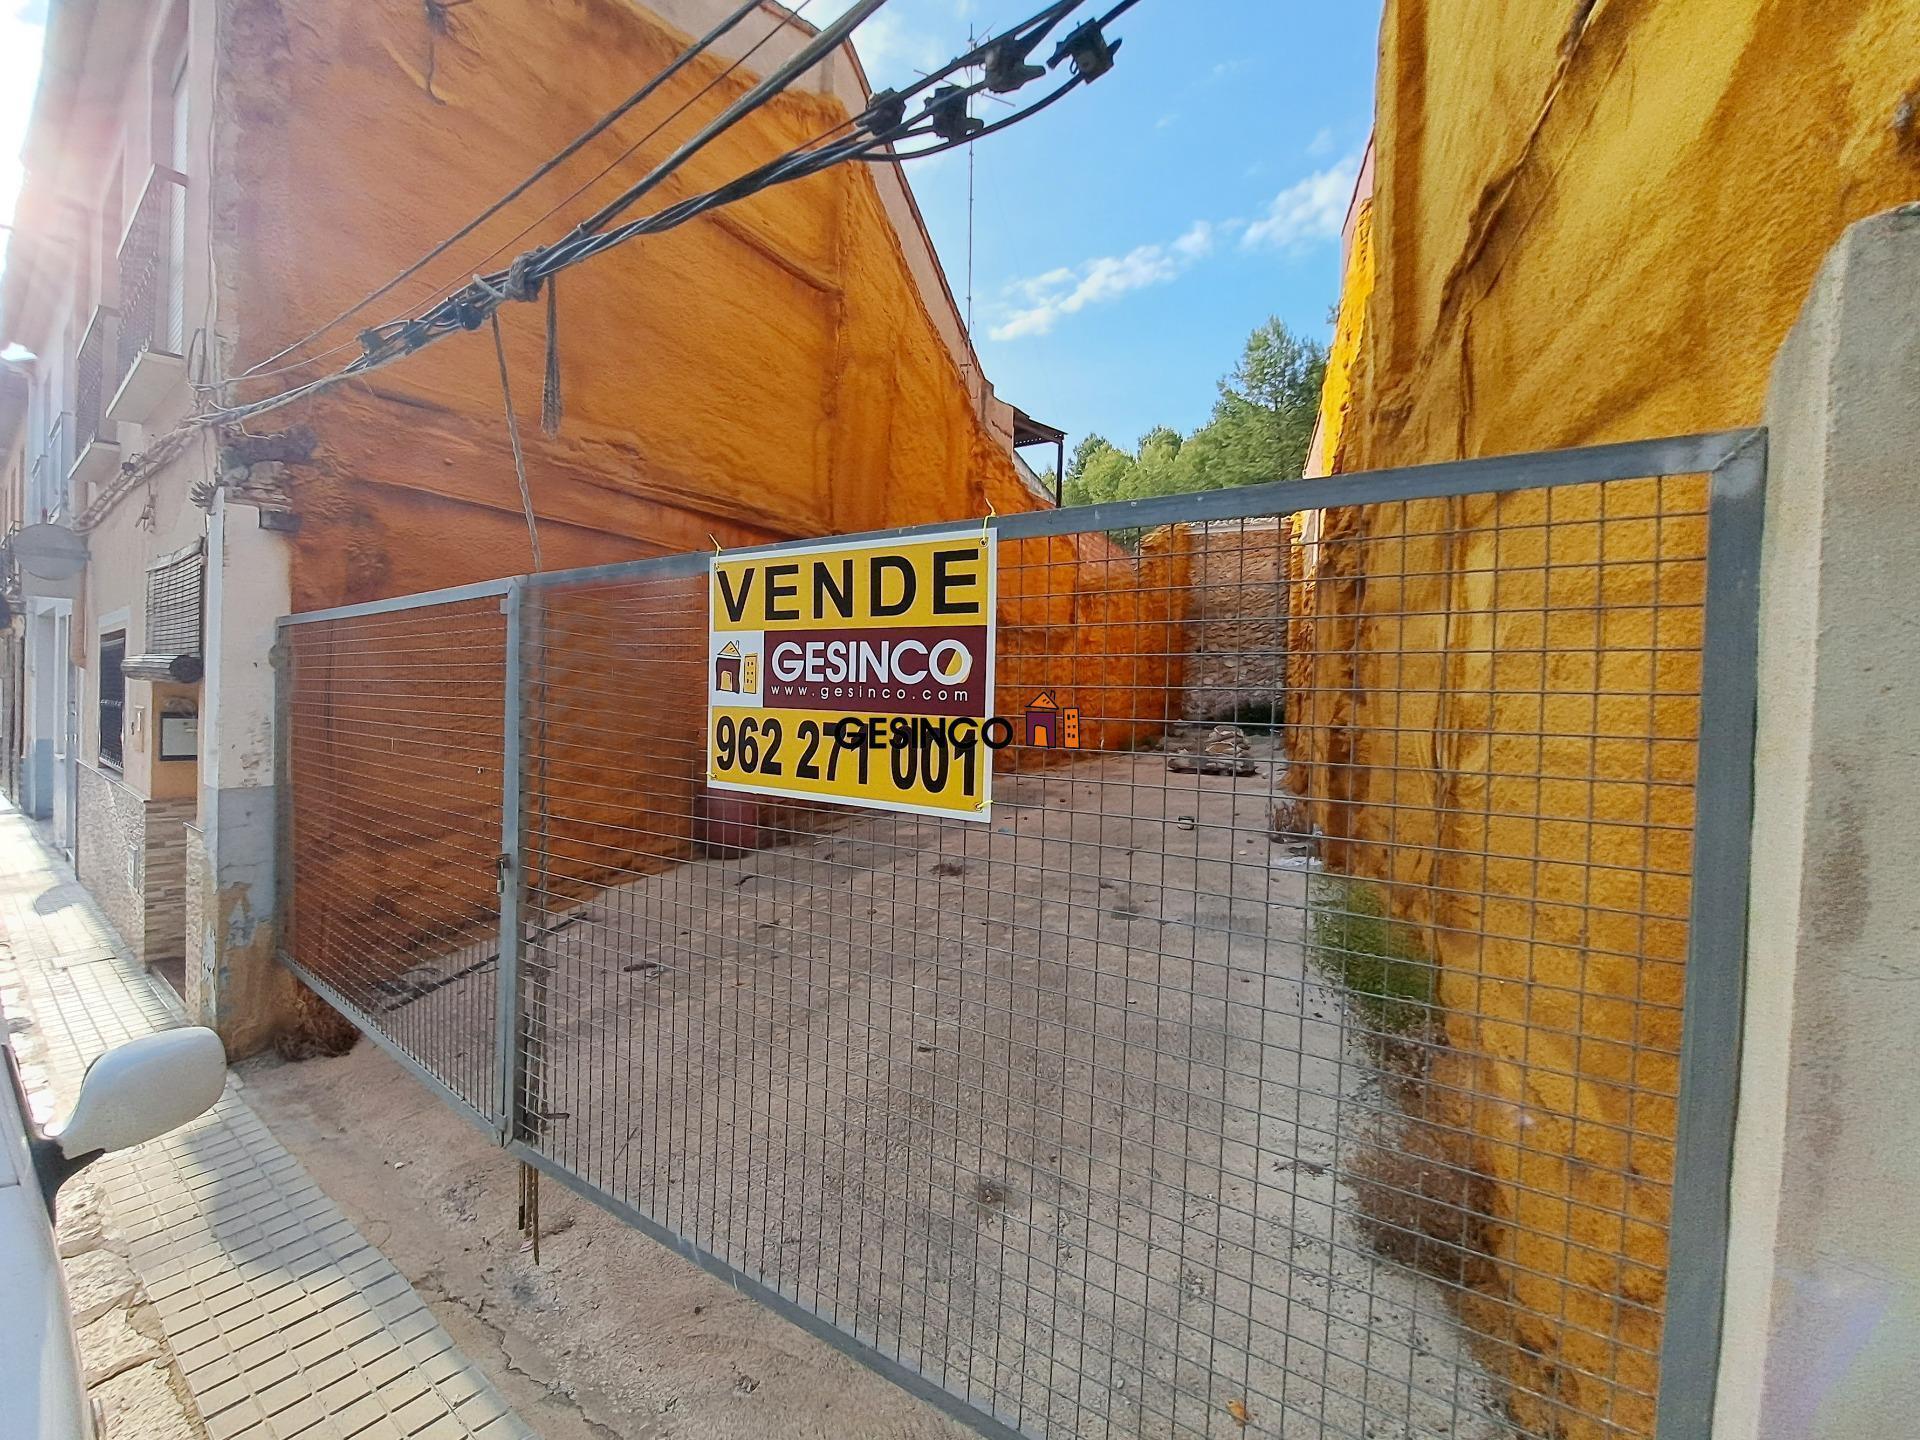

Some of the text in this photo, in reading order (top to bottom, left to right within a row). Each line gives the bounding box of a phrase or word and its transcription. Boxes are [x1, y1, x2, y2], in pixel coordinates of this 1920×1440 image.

[717, 548, 980, 622] VENDE
[771, 638, 973, 685] GESINCO
[770, 684, 969, 702] www.gesinco.com
[715, 715, 976, 796] 962 271 001
